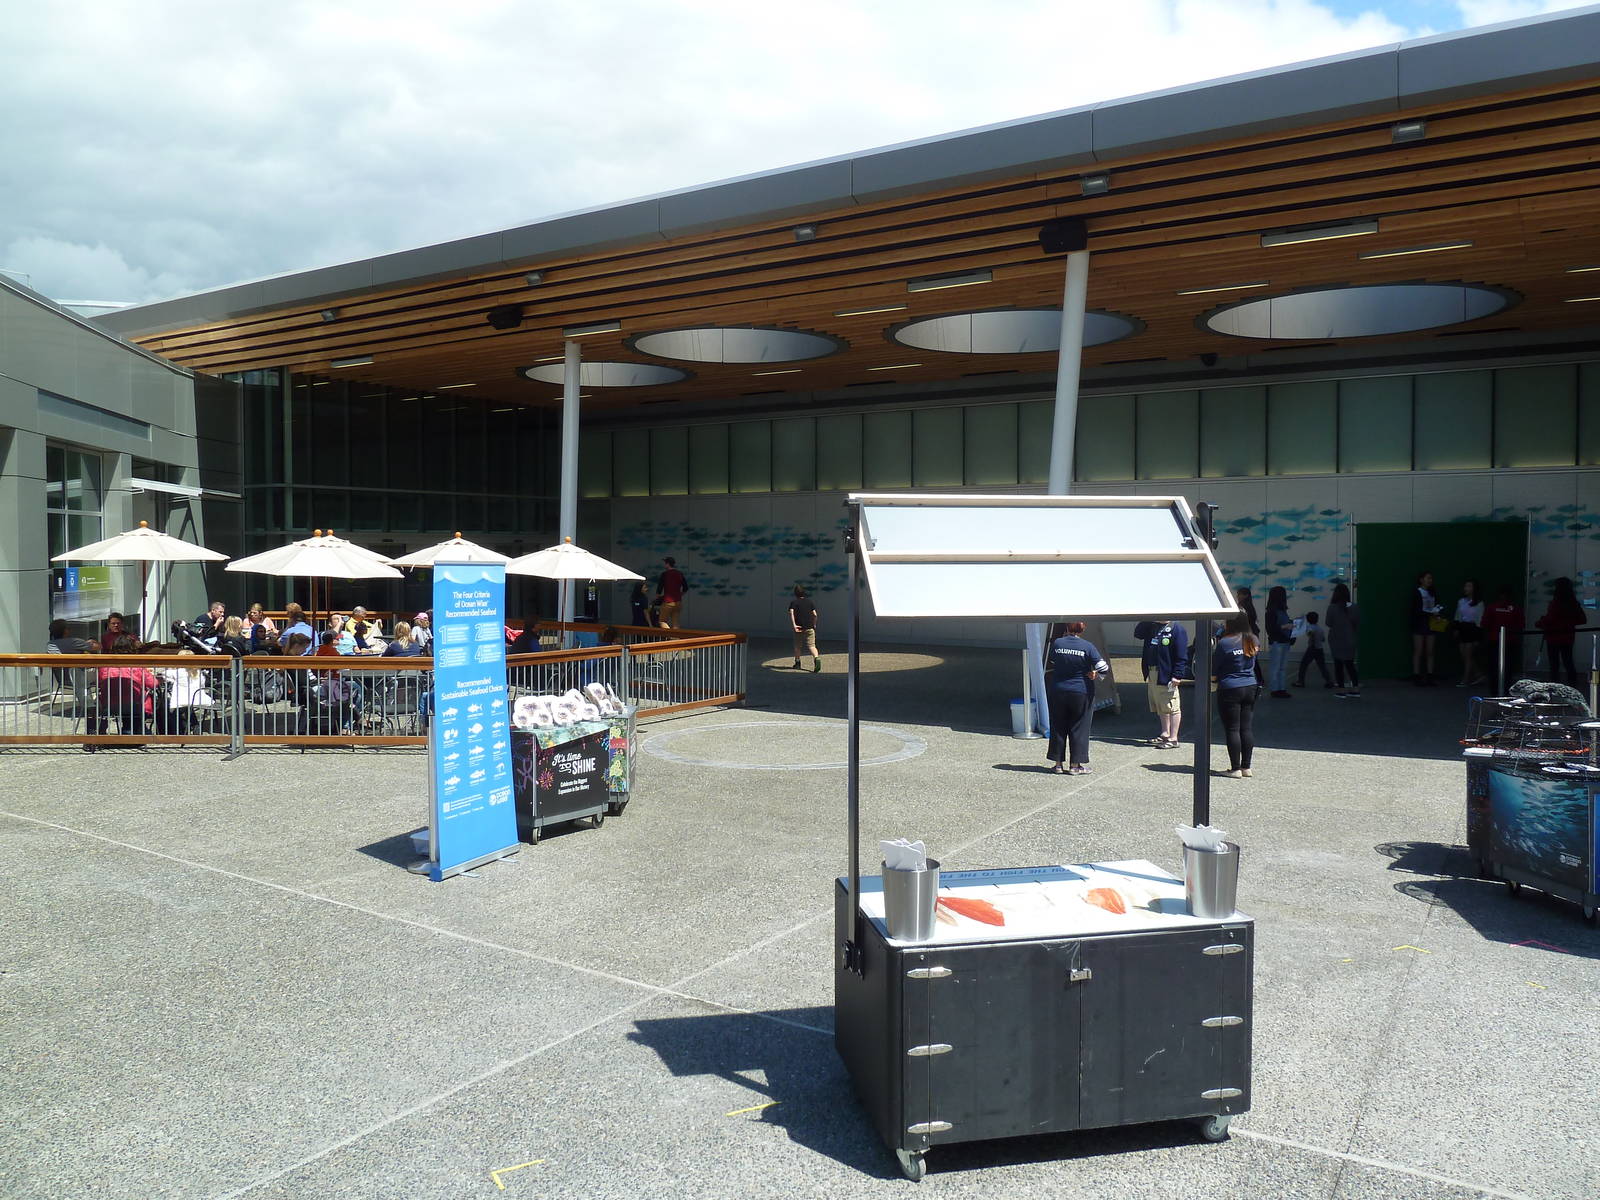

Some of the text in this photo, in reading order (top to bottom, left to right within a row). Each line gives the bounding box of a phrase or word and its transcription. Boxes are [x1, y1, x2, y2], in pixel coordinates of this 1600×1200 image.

[461, 600, 476, 608] Ocean
[446, 609, 480, 618] Recommended
[439, 625, 446, 645] 1
[475, 624, 482, 642] 2
[1054, 648, 1085, 657] VOLUNTEER
[456, 678, 491, 688] Recommended
[468, 686, 489, 696] Seafood
[552, 752, 582, 766] It's time
[572, 758, 596, 775] SHINE
